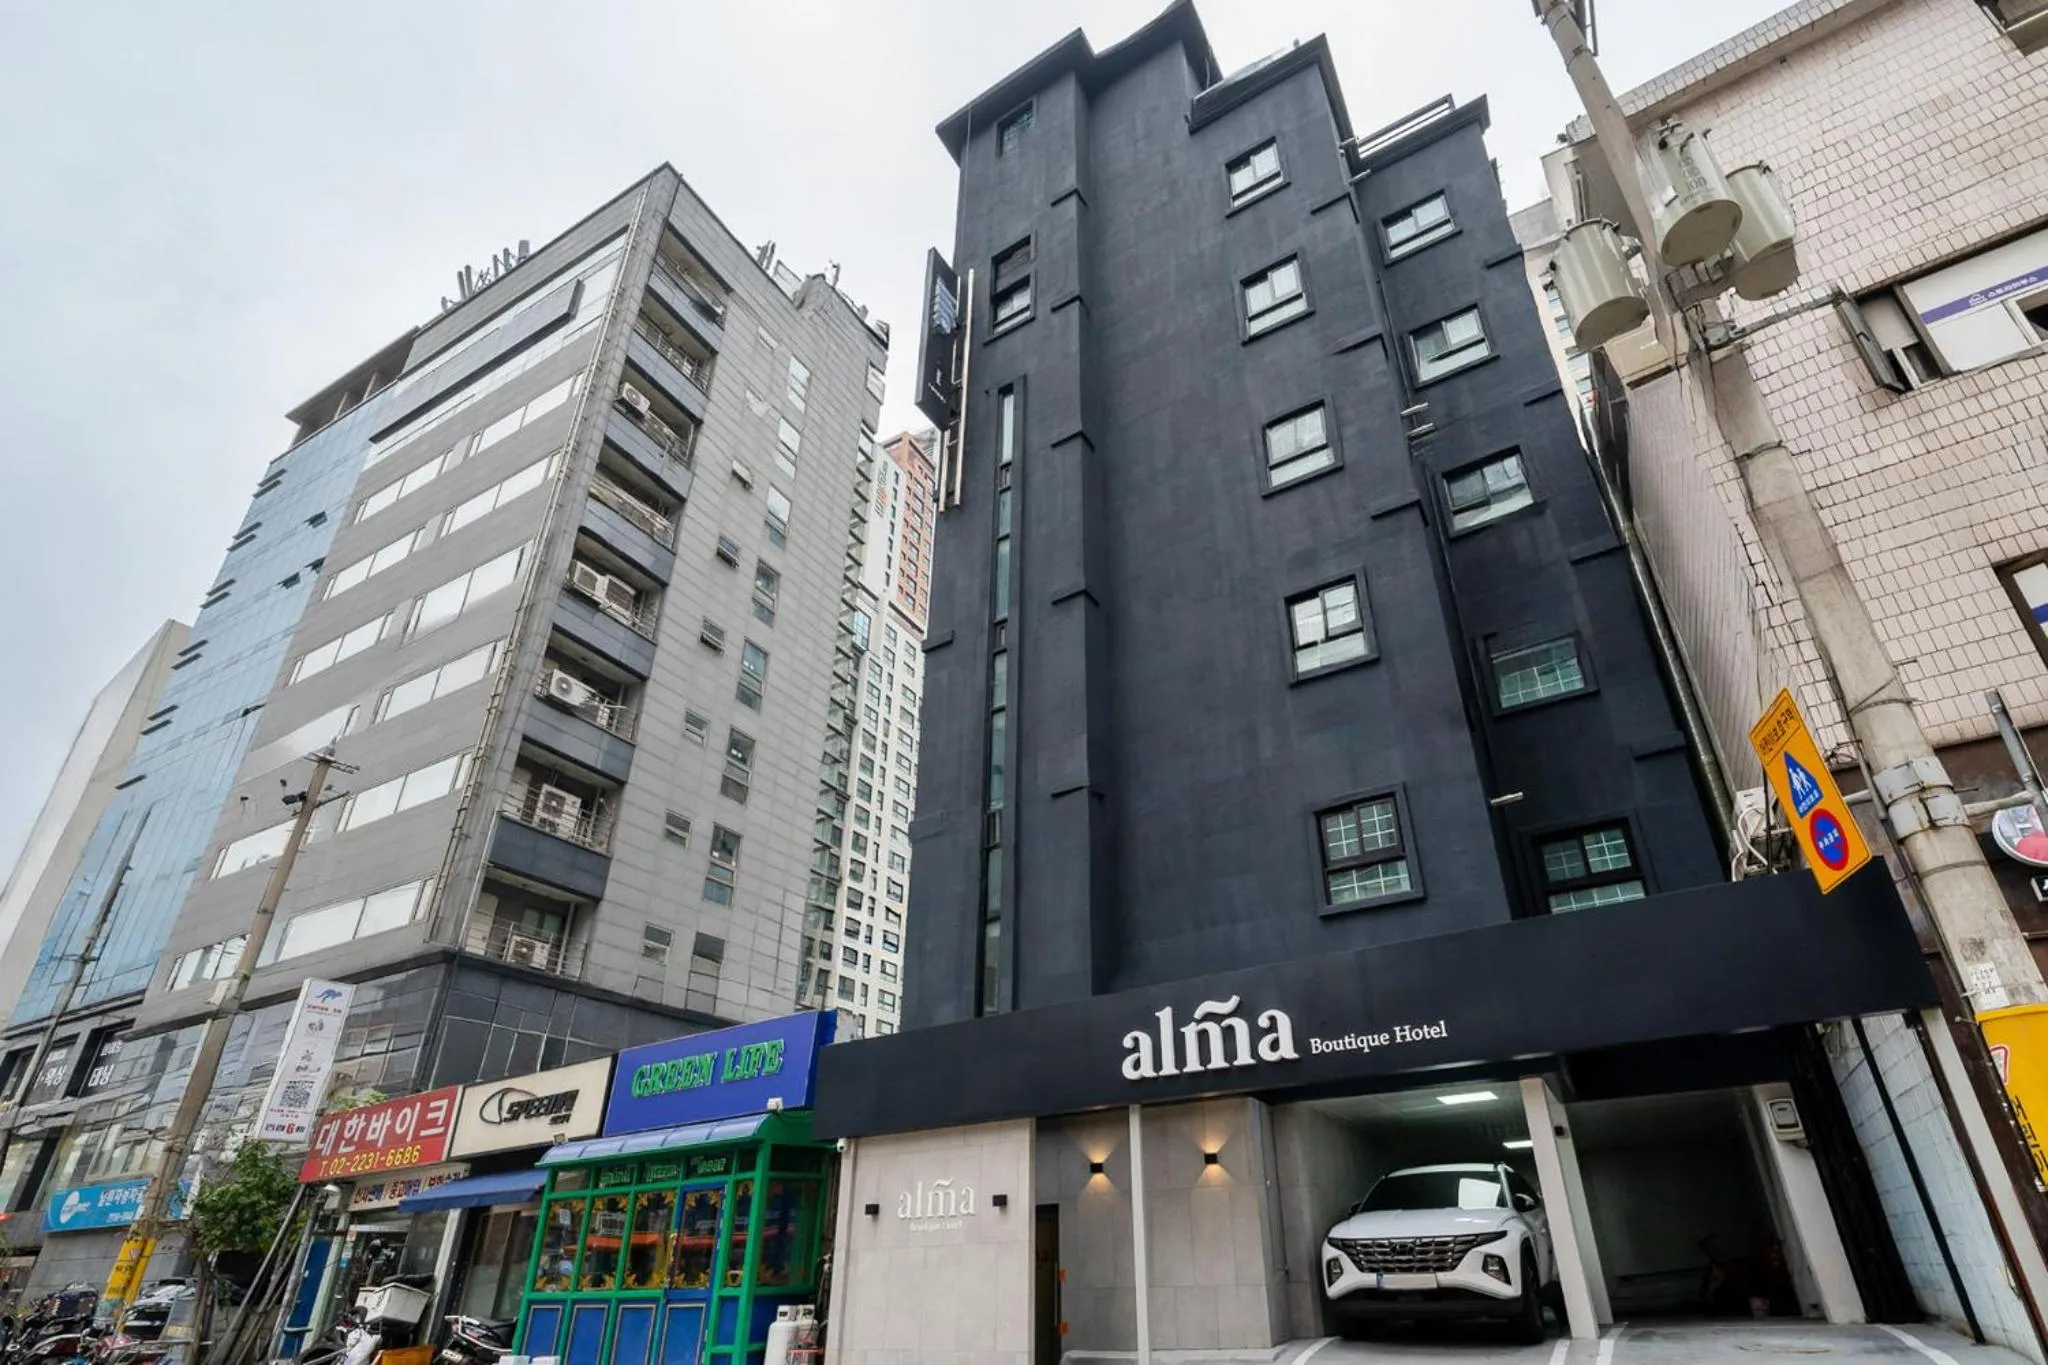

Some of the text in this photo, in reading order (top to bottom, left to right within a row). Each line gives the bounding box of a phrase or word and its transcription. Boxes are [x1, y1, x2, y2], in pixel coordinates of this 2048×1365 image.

[1310, 1029, 1390, 1054] Boutique
[1394, 1020, 1448, 1045] Hotel
[632, 1038, 785, 1098] GREEN LIFE
[315, 1098, 449, 1157] 대한바이크
